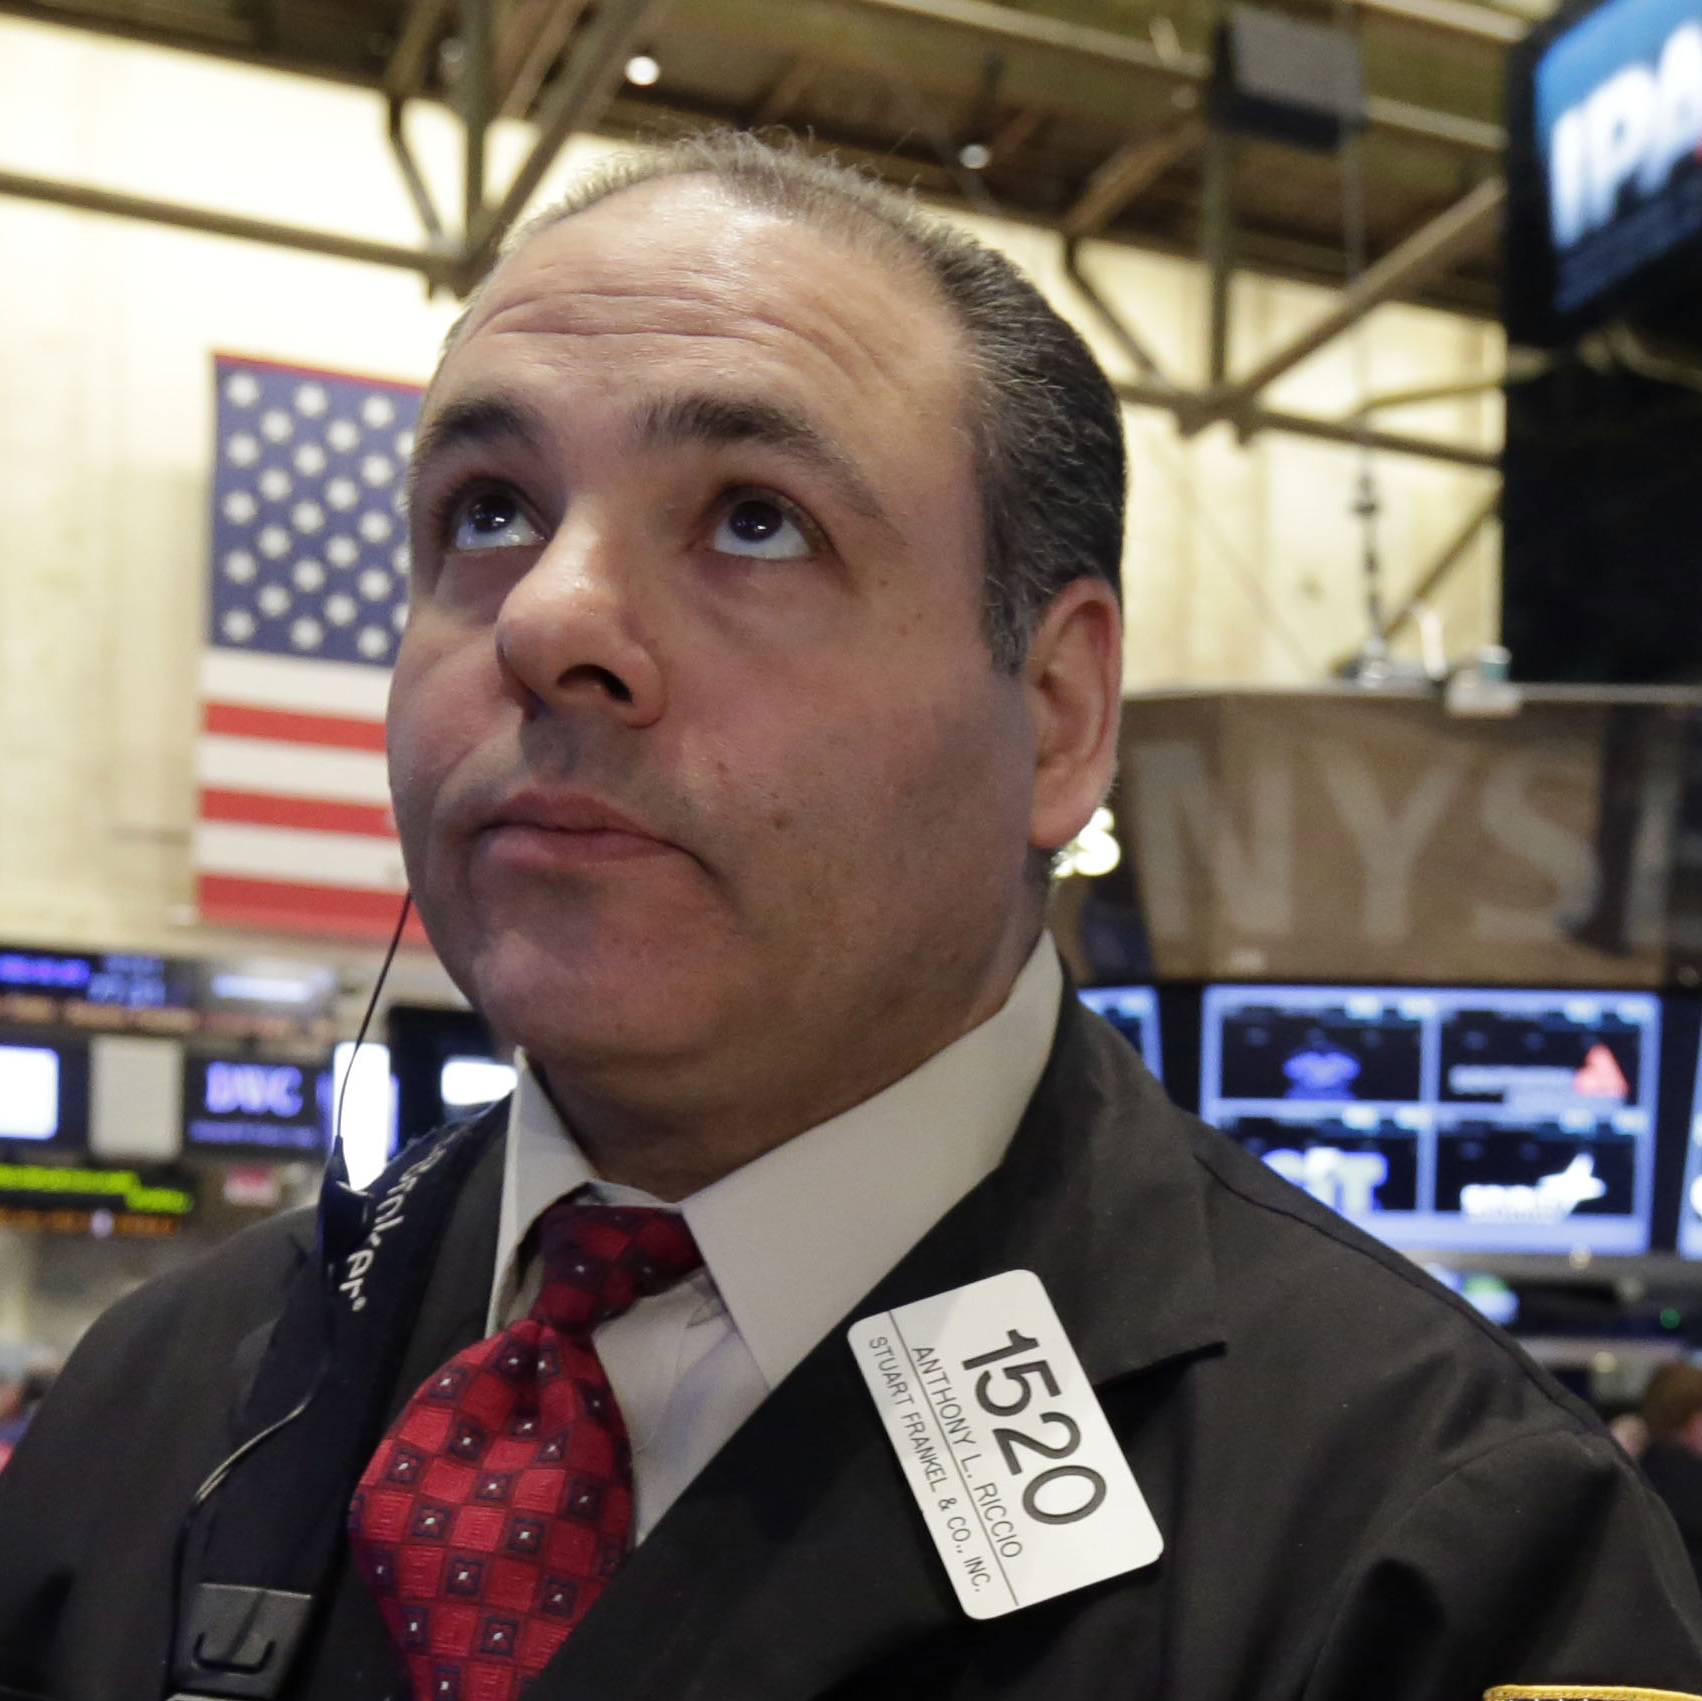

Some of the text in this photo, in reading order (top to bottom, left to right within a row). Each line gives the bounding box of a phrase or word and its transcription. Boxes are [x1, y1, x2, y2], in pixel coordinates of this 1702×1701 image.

[869, 1335, 916, 1413] STUART
[901, 1411, 949, 1493] FRANKEL
[938, 1497, 958, 1514] &
[964, 1555, 994, 1592] INC.
[912, 1346, 1024, 1559] ANTHONY L. RICCIO
[962, 1329, 1107, 1525] 1520
